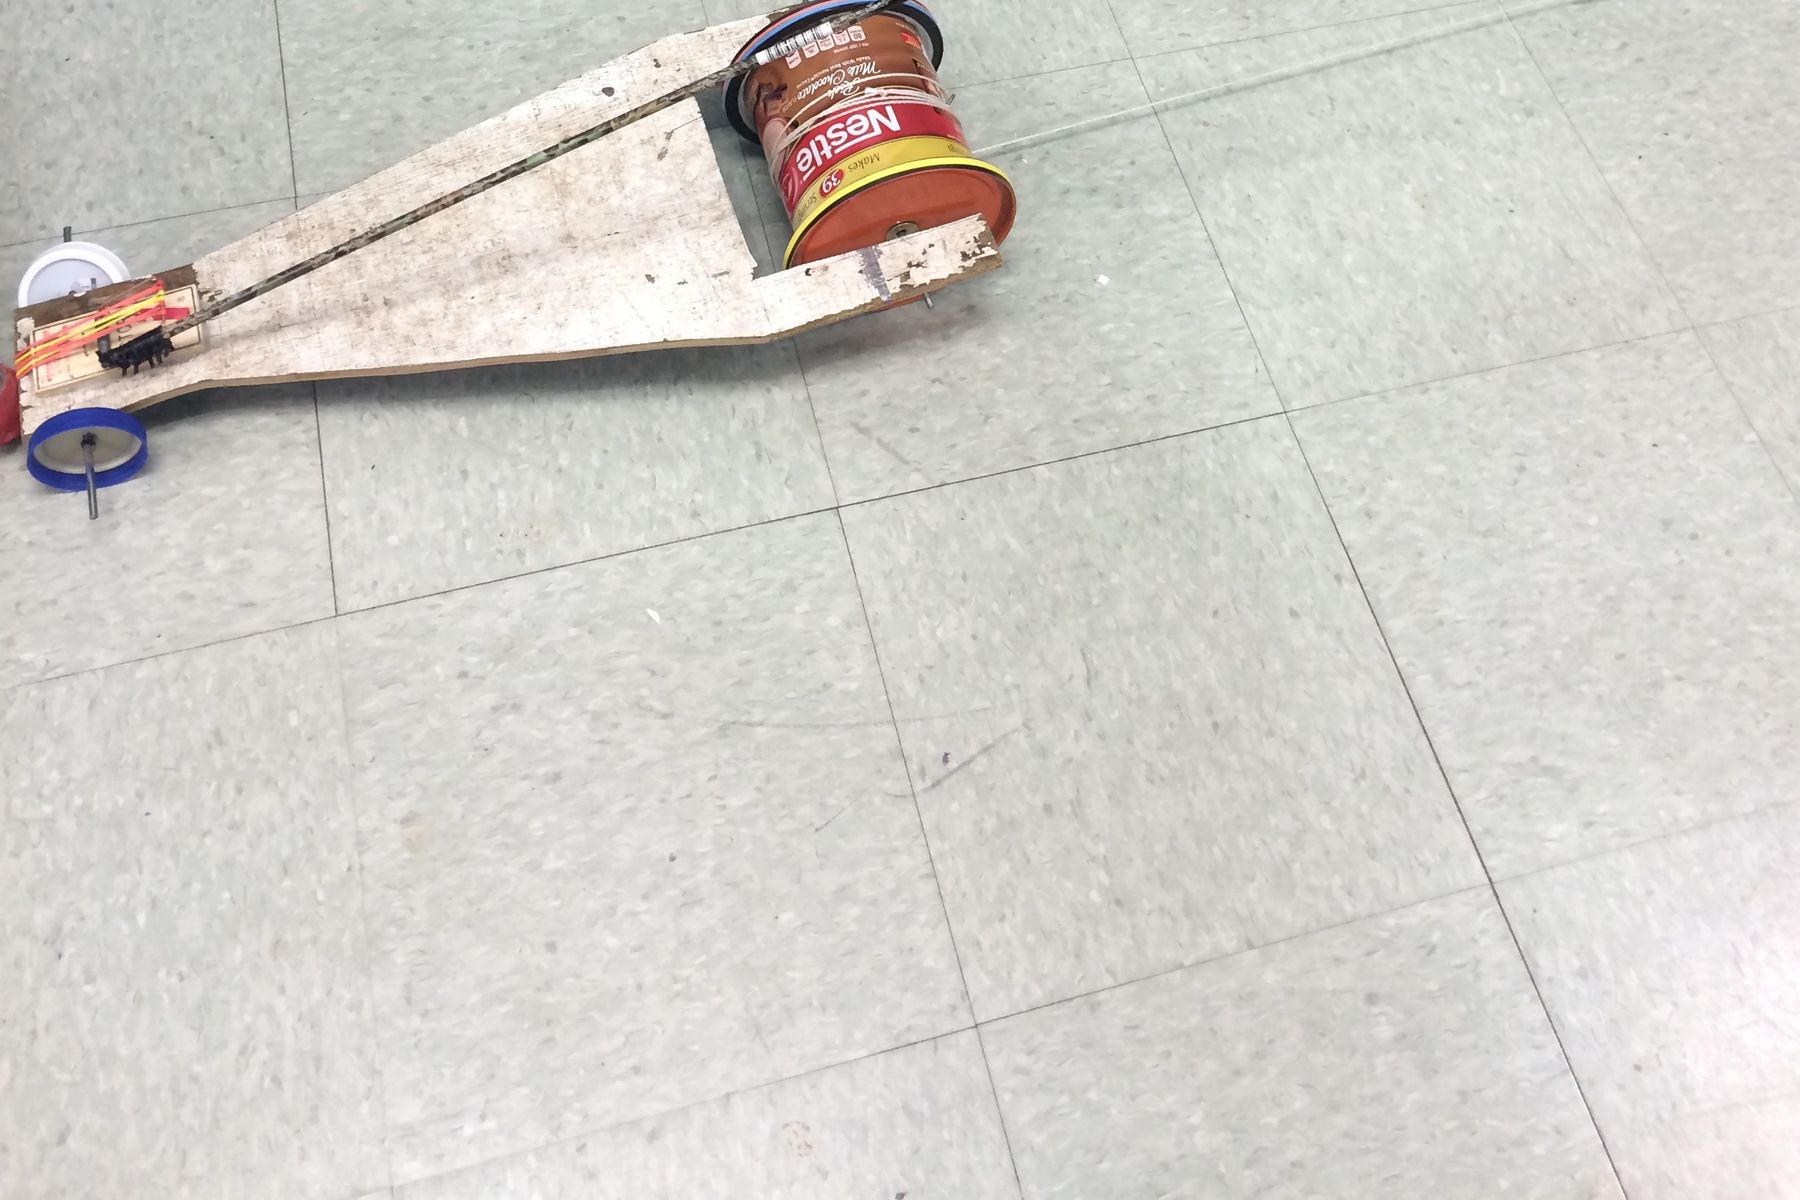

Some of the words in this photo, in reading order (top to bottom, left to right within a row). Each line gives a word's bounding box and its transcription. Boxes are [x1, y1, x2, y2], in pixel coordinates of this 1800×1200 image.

[847, 60, 881, 76] Milk
[797, 69, 846, 100] Chocolate
[827, 77, 860, 100] Rich
[796, 105, 901, 182] Nestlé
[847, 152, 881, 173] Makes
[822, 170, 842, 194] 39
